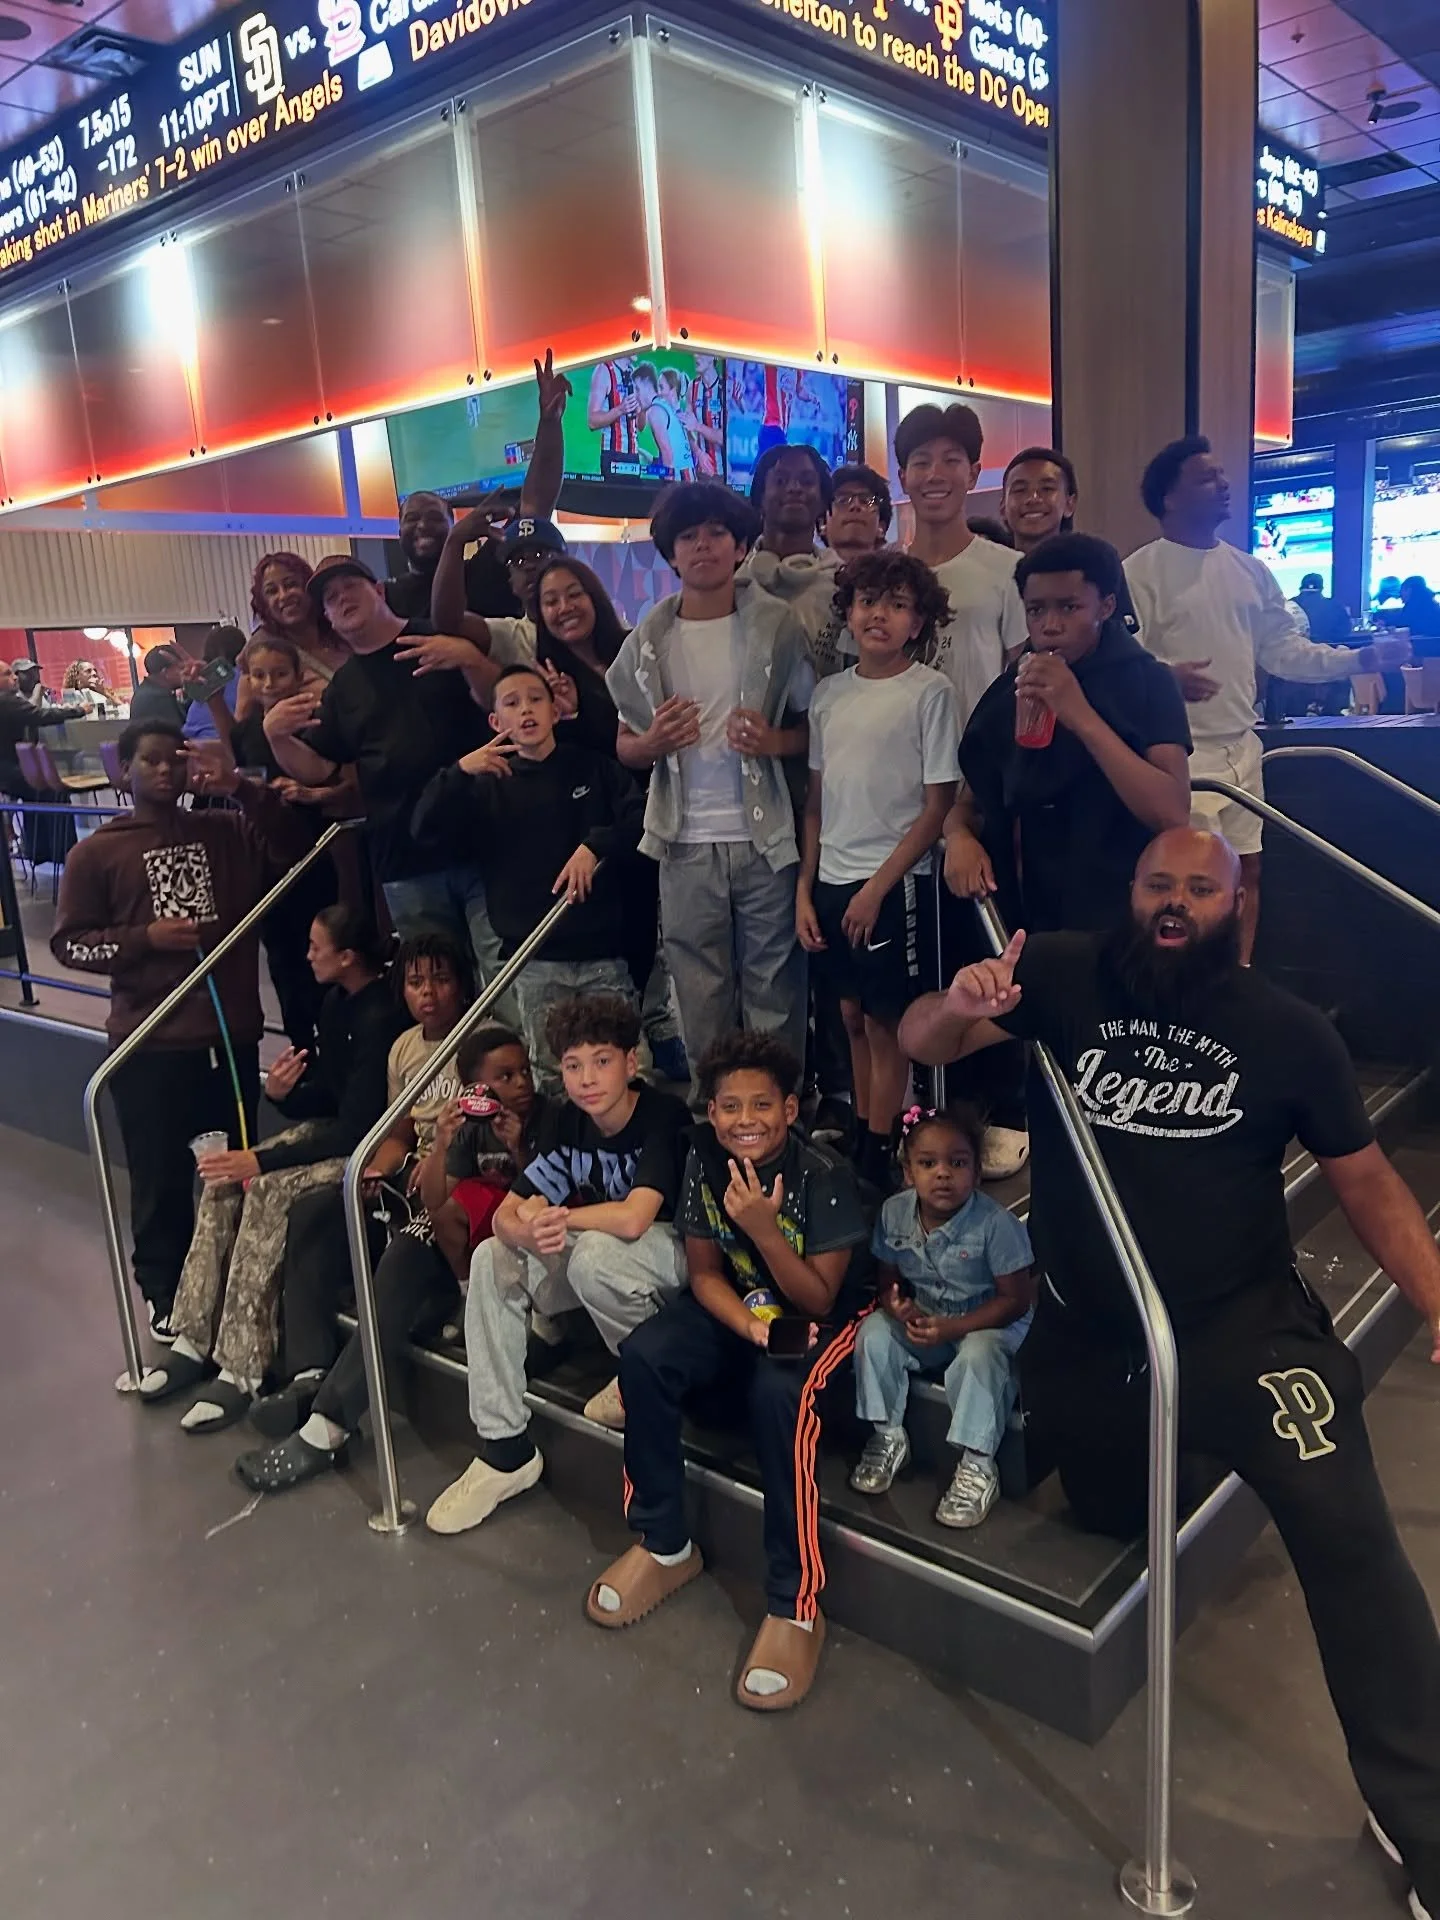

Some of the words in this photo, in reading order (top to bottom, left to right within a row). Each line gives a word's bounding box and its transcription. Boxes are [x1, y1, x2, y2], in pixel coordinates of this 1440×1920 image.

[179, 38, 222, 92] SUN
[284, 25, 317, 60] vs.
[852, 11, 877, 51] to
[882, 32, 939, 80] reach
[943, 53, 975, 96] the
[979, 67, 1008, 109] DC
[159, 80, 231, 148] 11:10PT
[34, 214, 66, 251] shot
[66, 206, 81, 235] in
[81, 162, 150, 226] Mariners'
[154, 146, 188, 189] 7-2
[190, 133, 222, 172] win
[226, 111, 269, 149] over
[274, 69, 344, 131] Angels
[97, 134, 138, 176] -172
[1099, 1019, 1126, 1040] THE
[1129, 1018, 1161, 1040] MAN,
[1168, 1024, 1196, 1046] THE
[1194, 1035, 1238, 1069] MYTH
[1144, 1045, 1180, 1072] The
[1074, 1048, 1242, 1125] Legend
[1258, 1367, 1337, 1461] P
